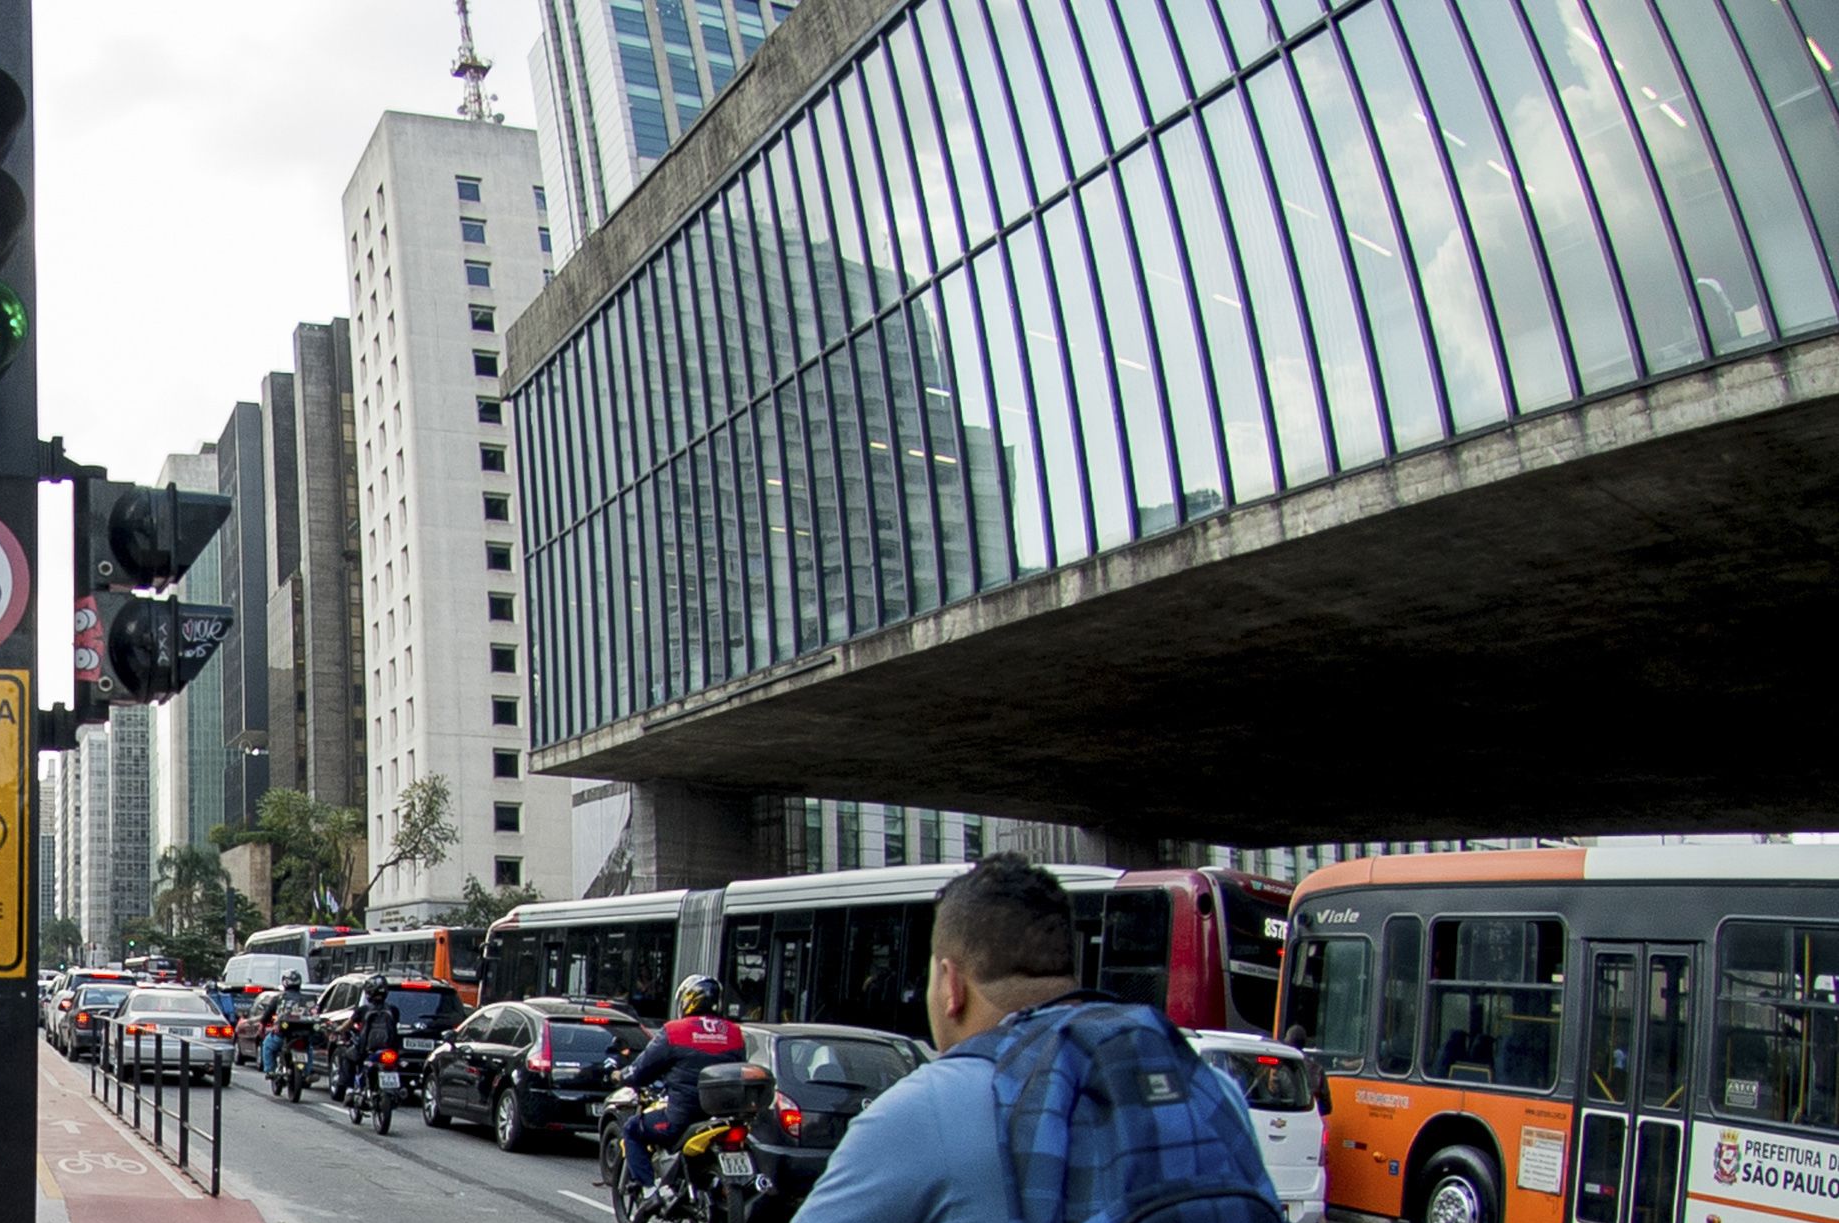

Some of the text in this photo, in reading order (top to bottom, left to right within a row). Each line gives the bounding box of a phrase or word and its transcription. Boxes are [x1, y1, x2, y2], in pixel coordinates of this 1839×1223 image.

[1316, 908, 1360, 924] Viale
[1744, 1139, 1822, 1168] PREFEITURA
[1741, 1159, 1839, 1199] SÃO PAULO
